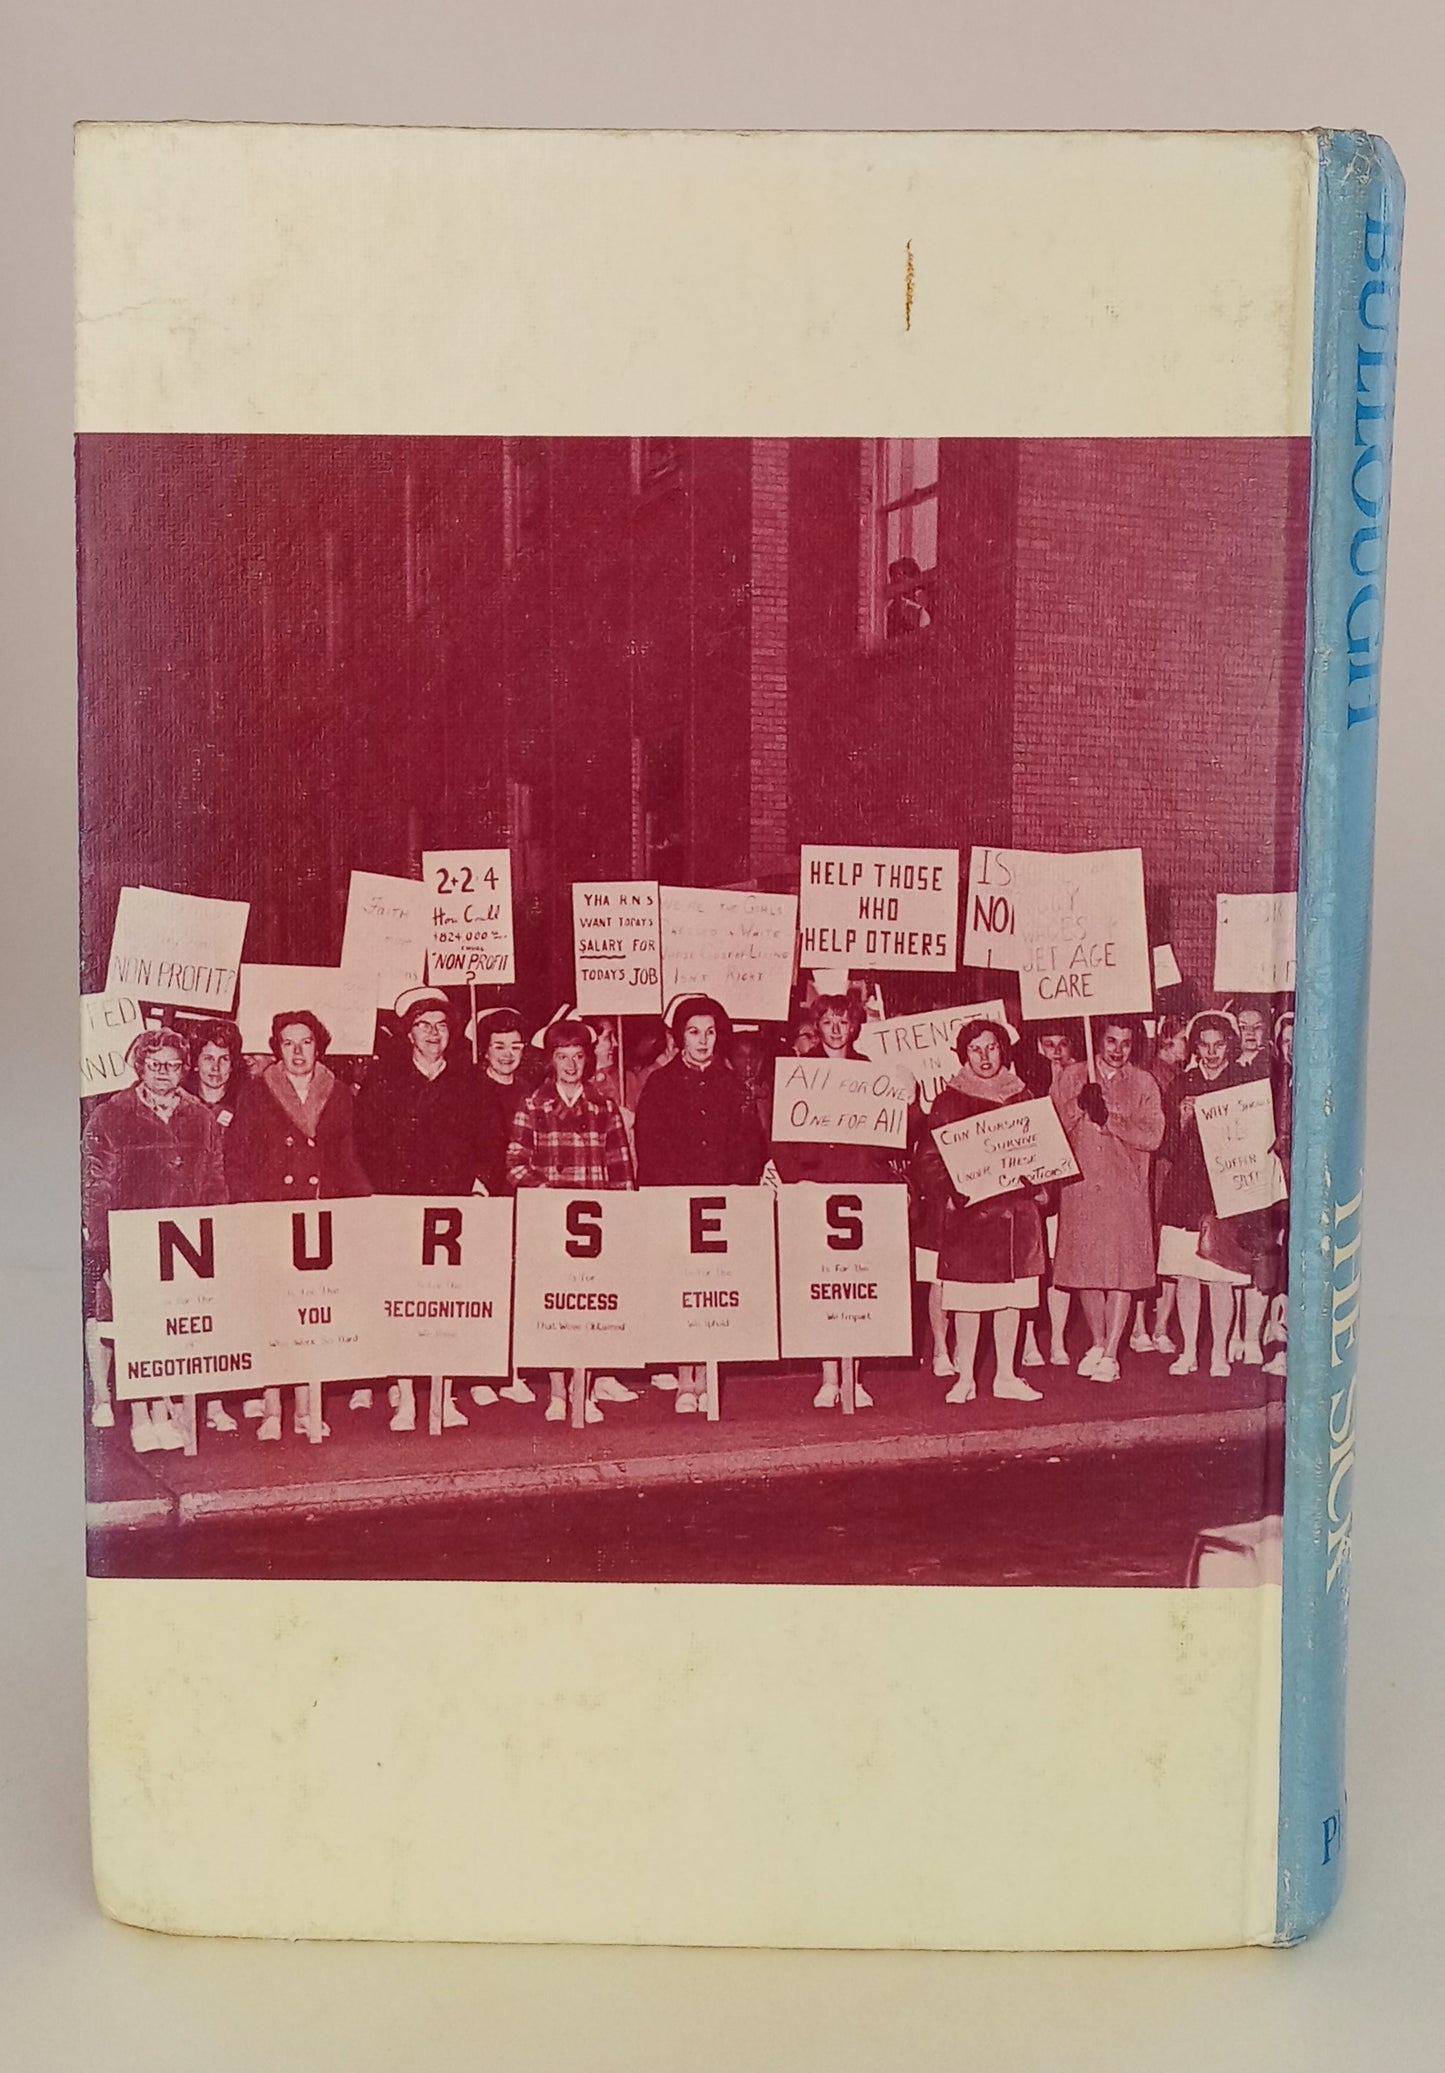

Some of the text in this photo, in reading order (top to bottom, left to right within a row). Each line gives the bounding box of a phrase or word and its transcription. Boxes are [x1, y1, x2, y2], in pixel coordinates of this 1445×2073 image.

[483, 867, 499, 890] 4
[810, 861, 943, 891] HELP THOSE
[584, 894, 610, 906] YHA
[859, 896, 898, 921] WHO
[579, 917, 611, 928] WANT
[579, 939, 623, 953] SALARY
[632, 939, 656, 952] FOR
[804, 927, 946, 956] HELP OTHERS
[1022, 946, 1057, 973] JET
[1069, 942, 1117, 970] AGE
[581, 967, 659, 987] TODAYS JOB
[1038, 973, 1093, 1000] CARE
[1201, 1103, 1229, 1121] WHY
[544, 1292, 618, 1310] SUCCESS
[682, 1291, 740, 1308] ETHICS
[810, 1283, 878, 1300] SERVICE
[298, 1307, 332, 1325] YOU
[384, 1300, 493, 1318] RECOGNITION
[166, 1315, 213, 1336] NEED
[128, 1352, 252, 1379] NEGOTIATIONS
